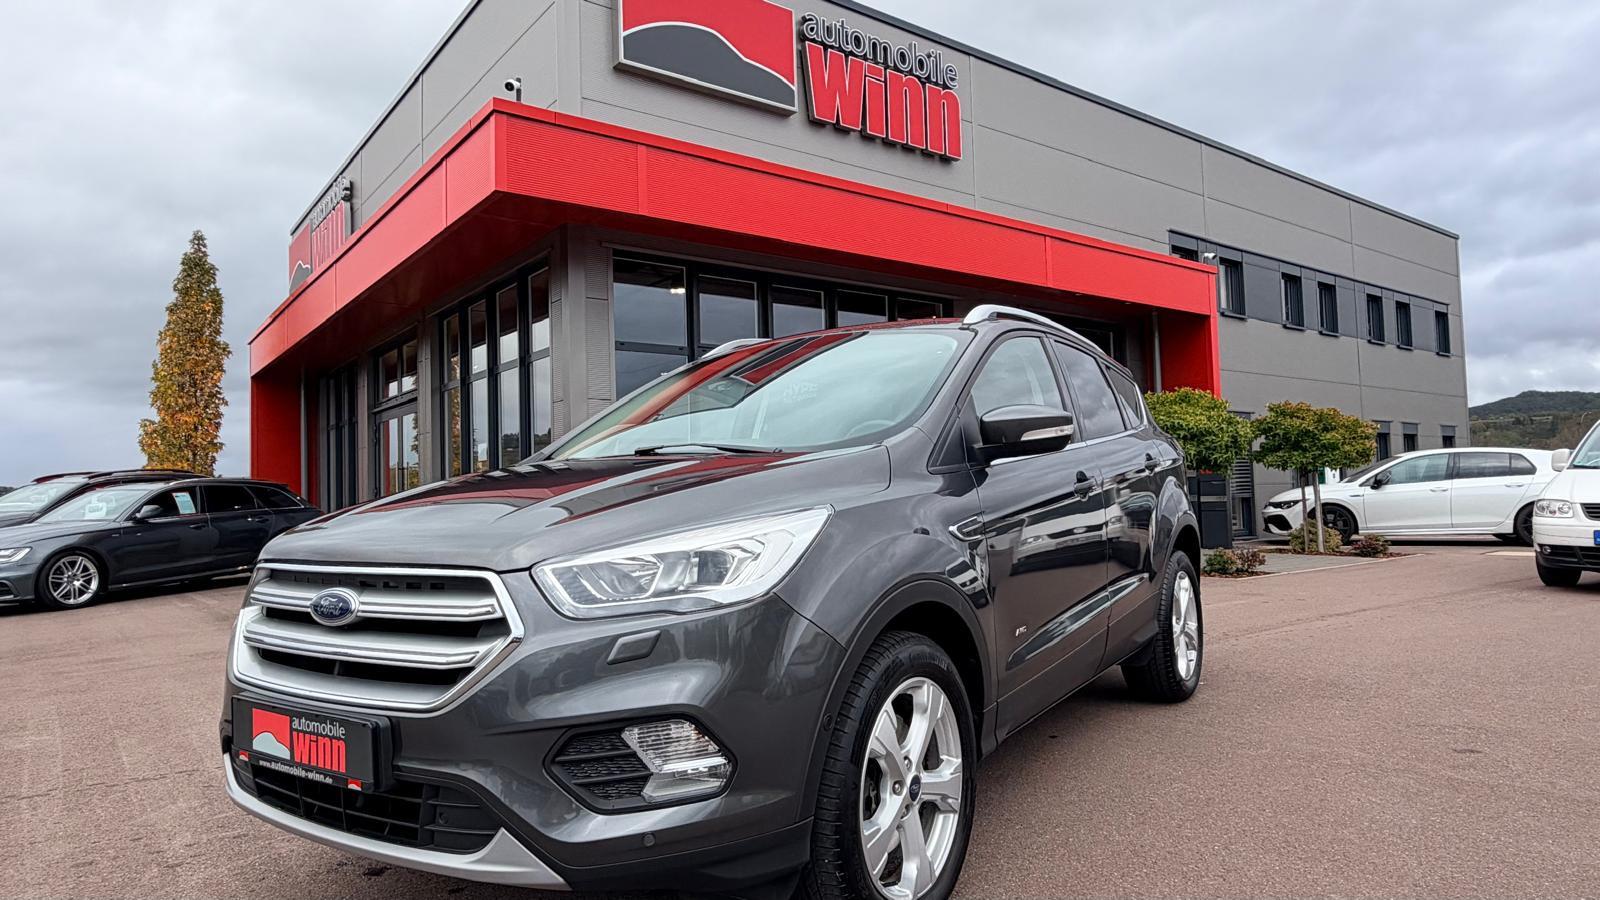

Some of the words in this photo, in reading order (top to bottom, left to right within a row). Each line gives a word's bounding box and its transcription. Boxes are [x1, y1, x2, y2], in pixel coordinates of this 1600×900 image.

[803, 12, 958, 89] automobile
[291, 716, 346, 738] automobile
[259, 760, 333, 784] www.automobile-winn.de
